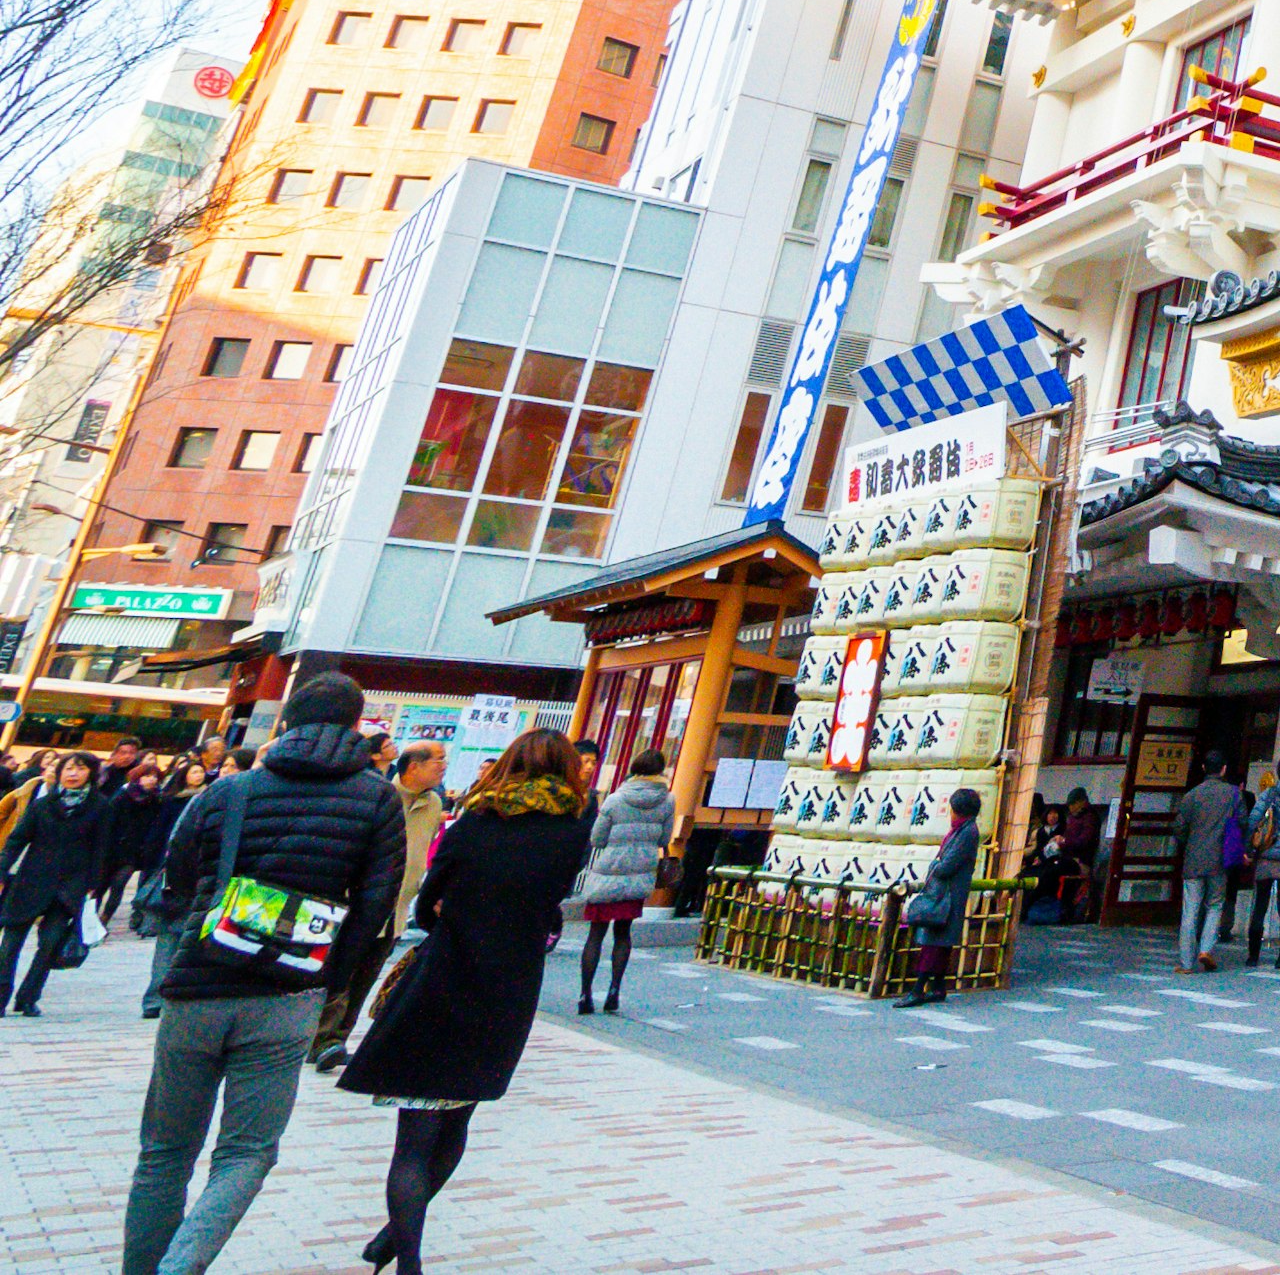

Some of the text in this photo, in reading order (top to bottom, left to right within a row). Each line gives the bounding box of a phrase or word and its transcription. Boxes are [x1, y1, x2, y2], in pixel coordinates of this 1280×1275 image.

[751, 51, 917, 511] 歌舞伎座
[113, 593, 184, 611] PALAZZO
[468, 708, 509, 724] 最後尾
[1147, 762, 1177, 774] 入口
